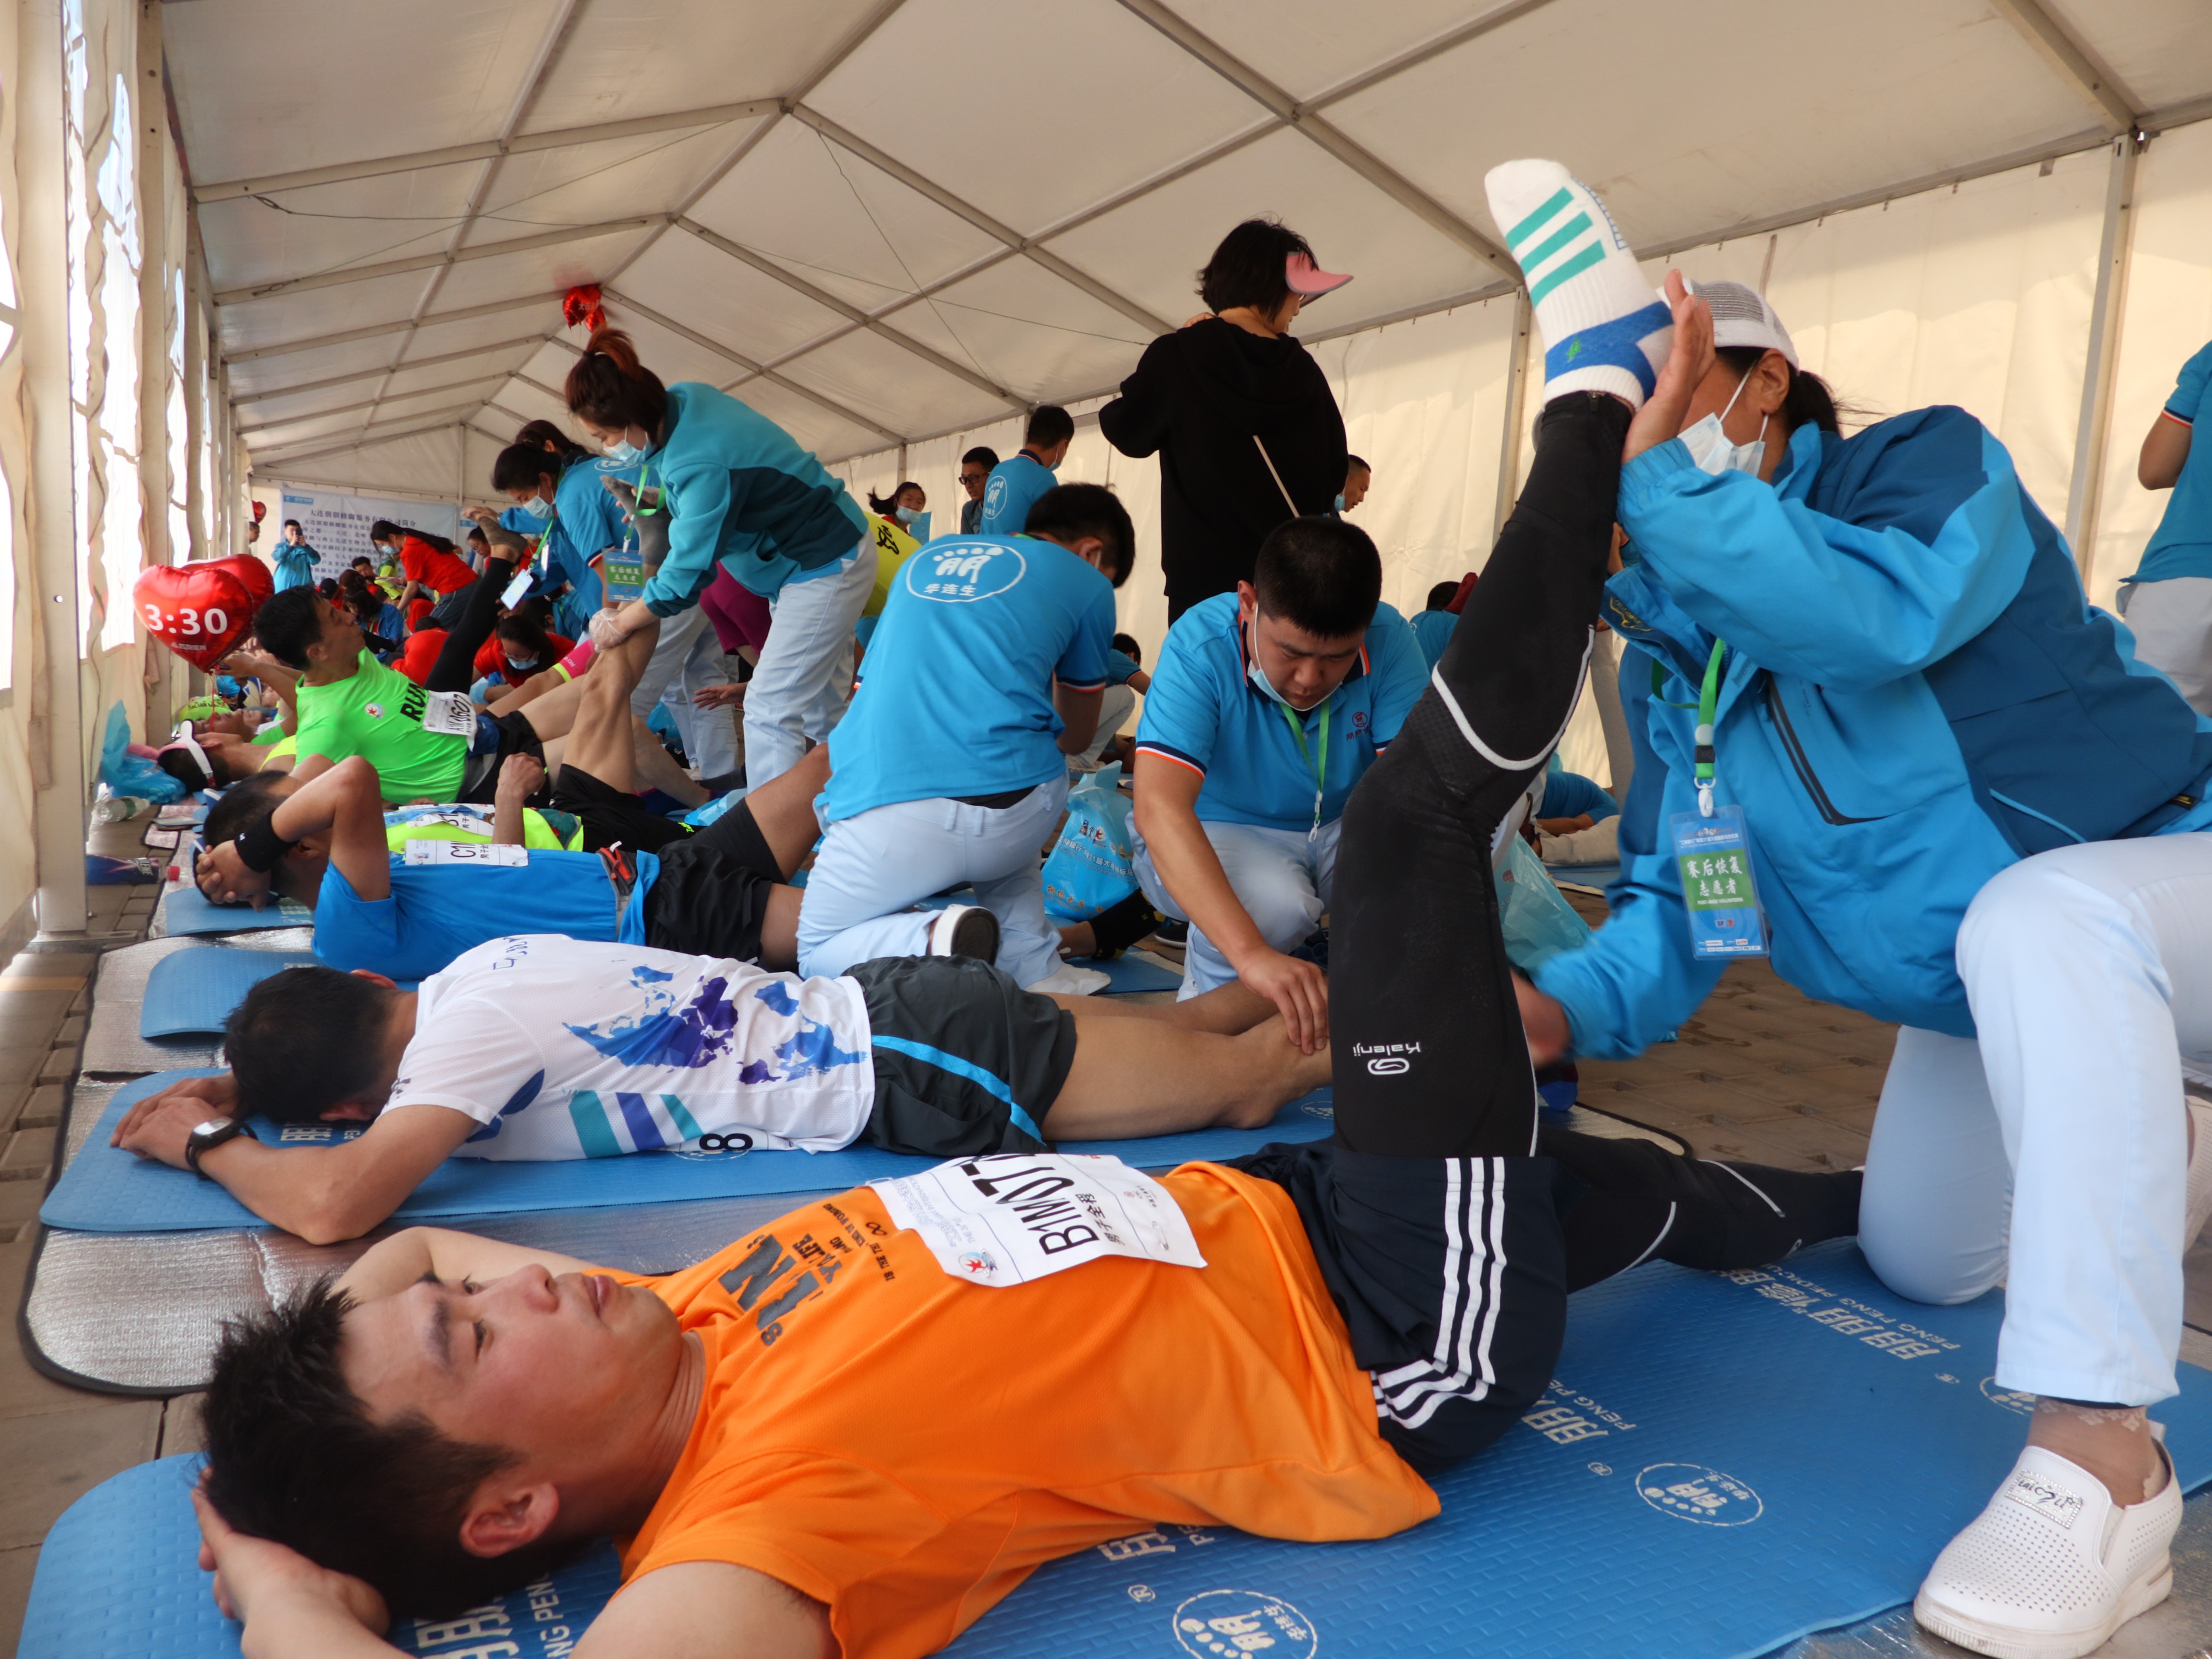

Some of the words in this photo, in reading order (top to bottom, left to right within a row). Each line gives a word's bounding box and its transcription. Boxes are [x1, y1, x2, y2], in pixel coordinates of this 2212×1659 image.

[145, 604, 228, 635] 3:30
[1687, 855, 1743, 878] 赛后恢复
[1699, 878, 1736, 896] 志愿者
[1353, 1042, 1421, 1057] Kalenji
[1839, 1297, 1897, 1324] PENG
[1898, 1323, 1961, 1350] PENG
[1573, 1396, 1636, 1431] PENG
